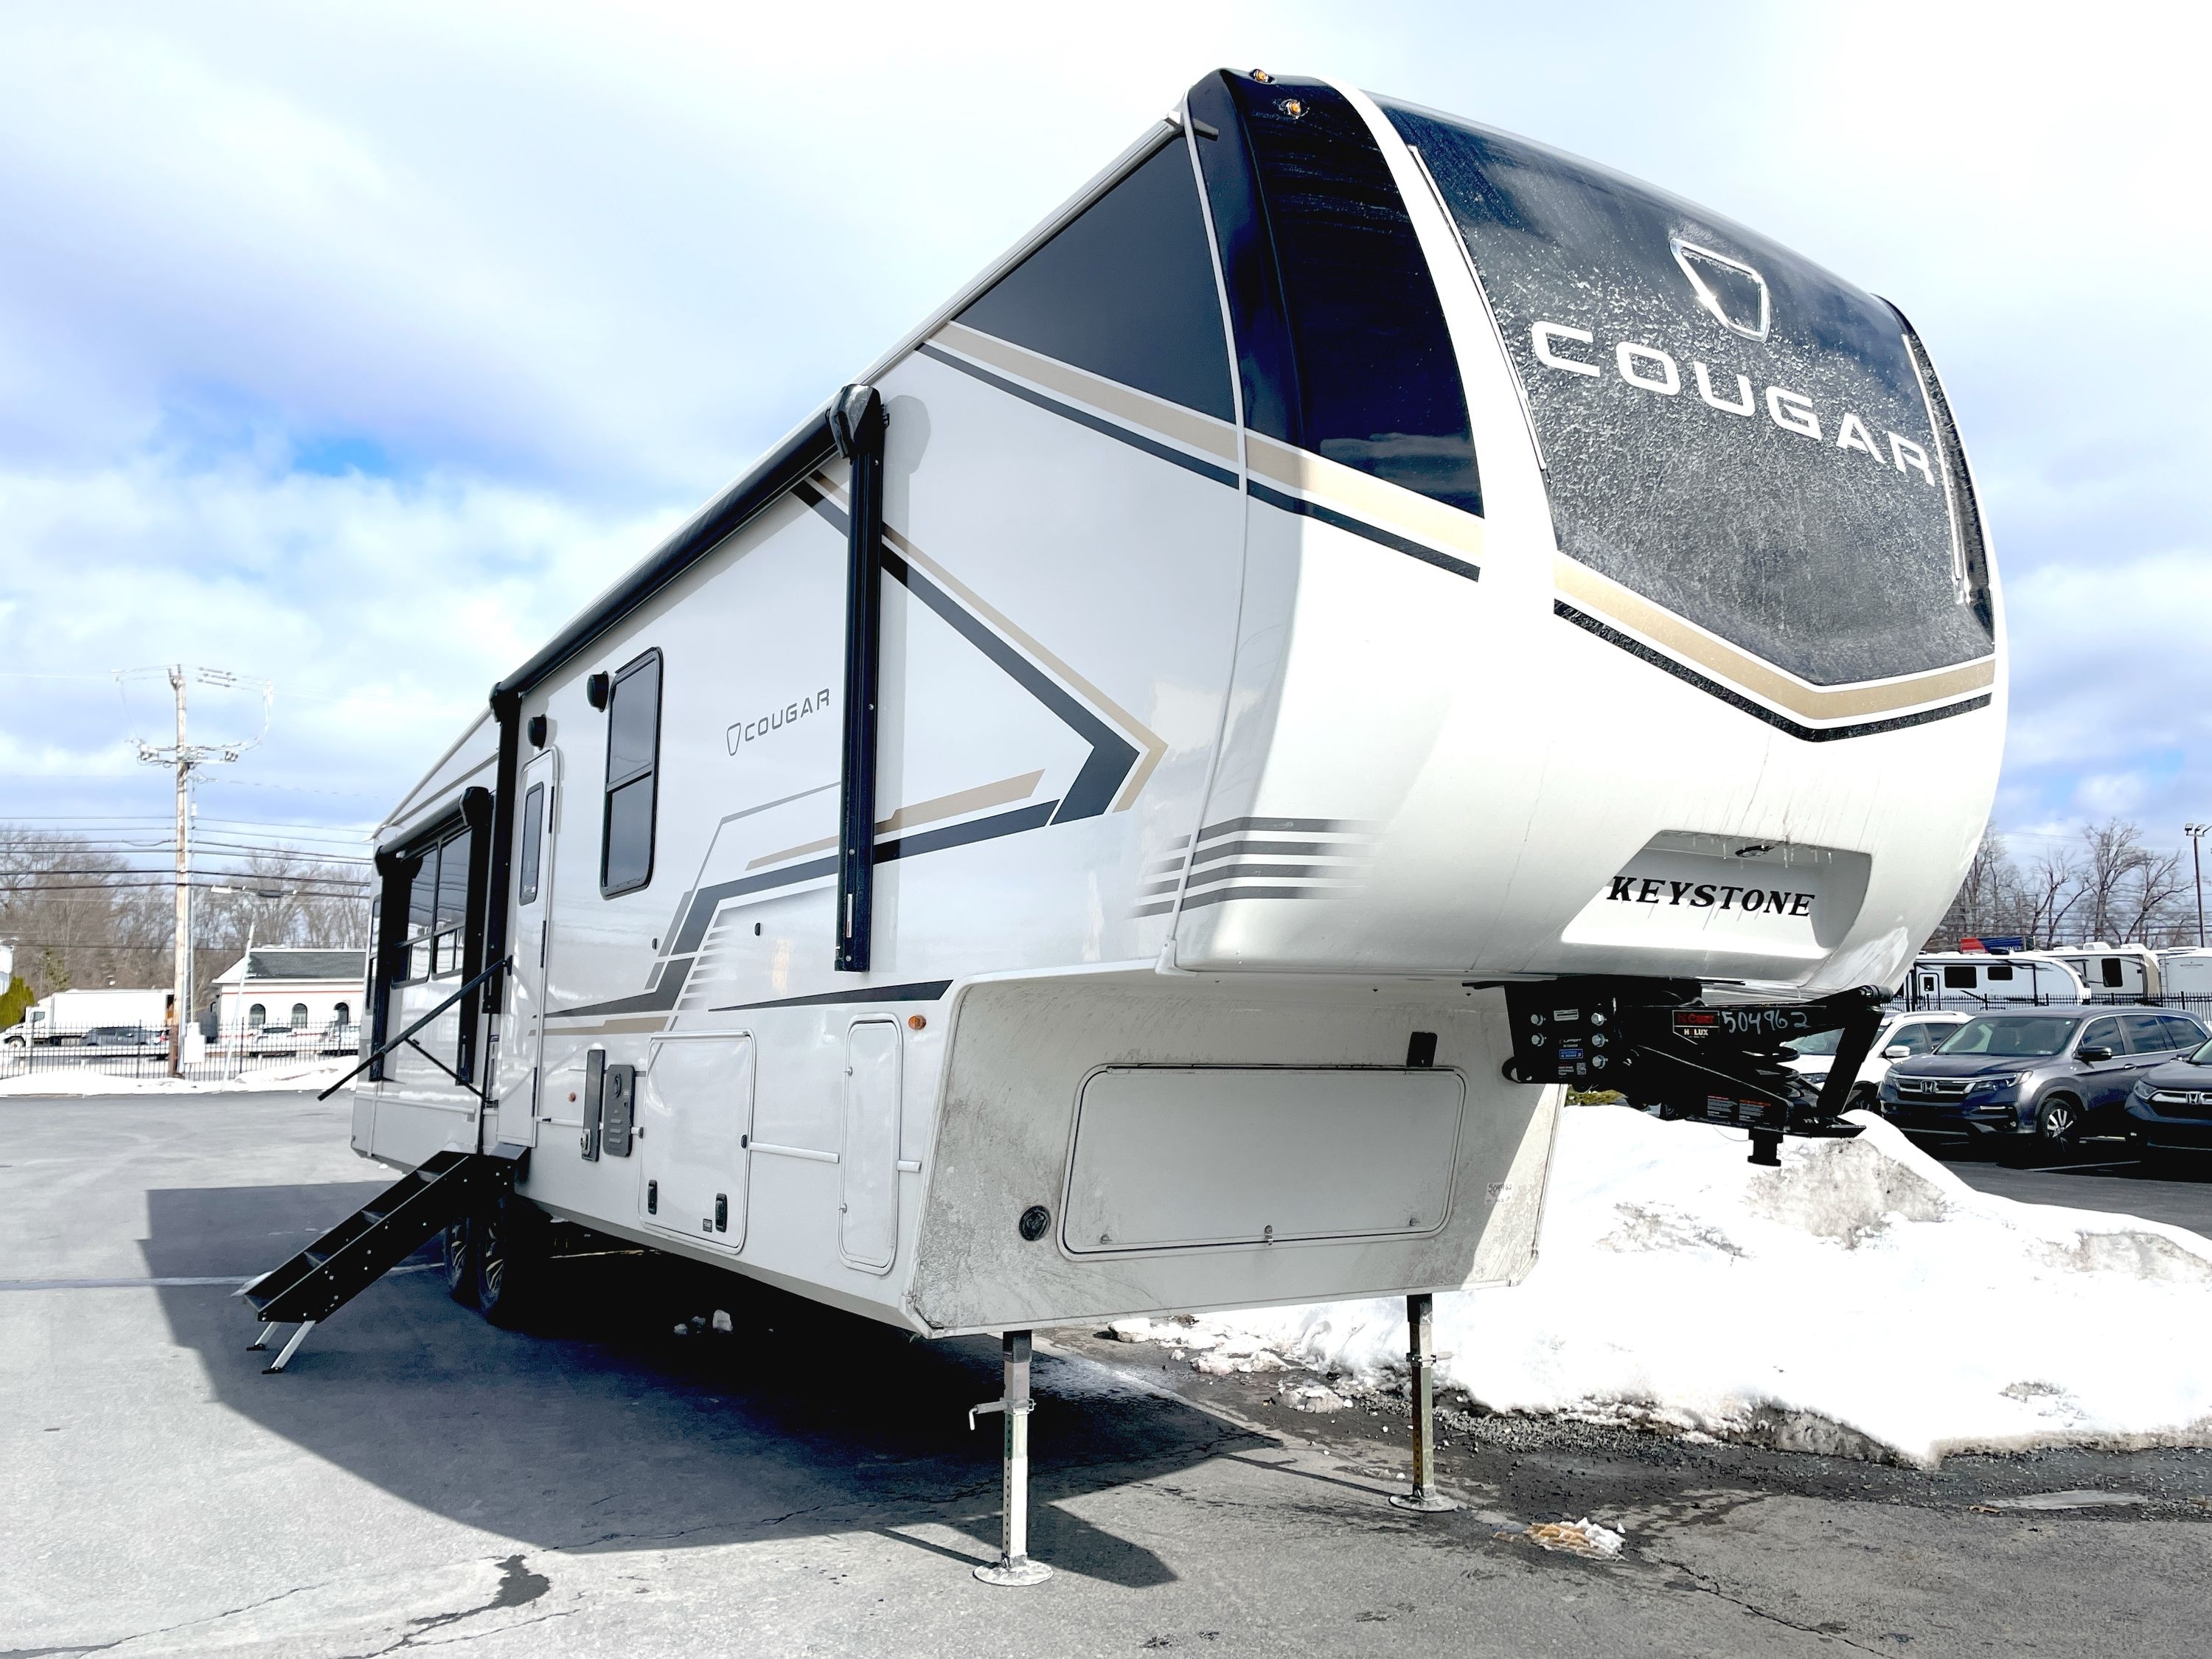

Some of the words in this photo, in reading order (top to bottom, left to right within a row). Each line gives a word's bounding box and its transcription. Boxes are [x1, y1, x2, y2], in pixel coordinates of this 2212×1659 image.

[1530, 320, 1935, 487] COUGAR
[745, 688, 830, 742] COUGAR
[1606, 875, 1815, 917] KEYSTONE
[1721, 1009, 1812, 1035] 504962
